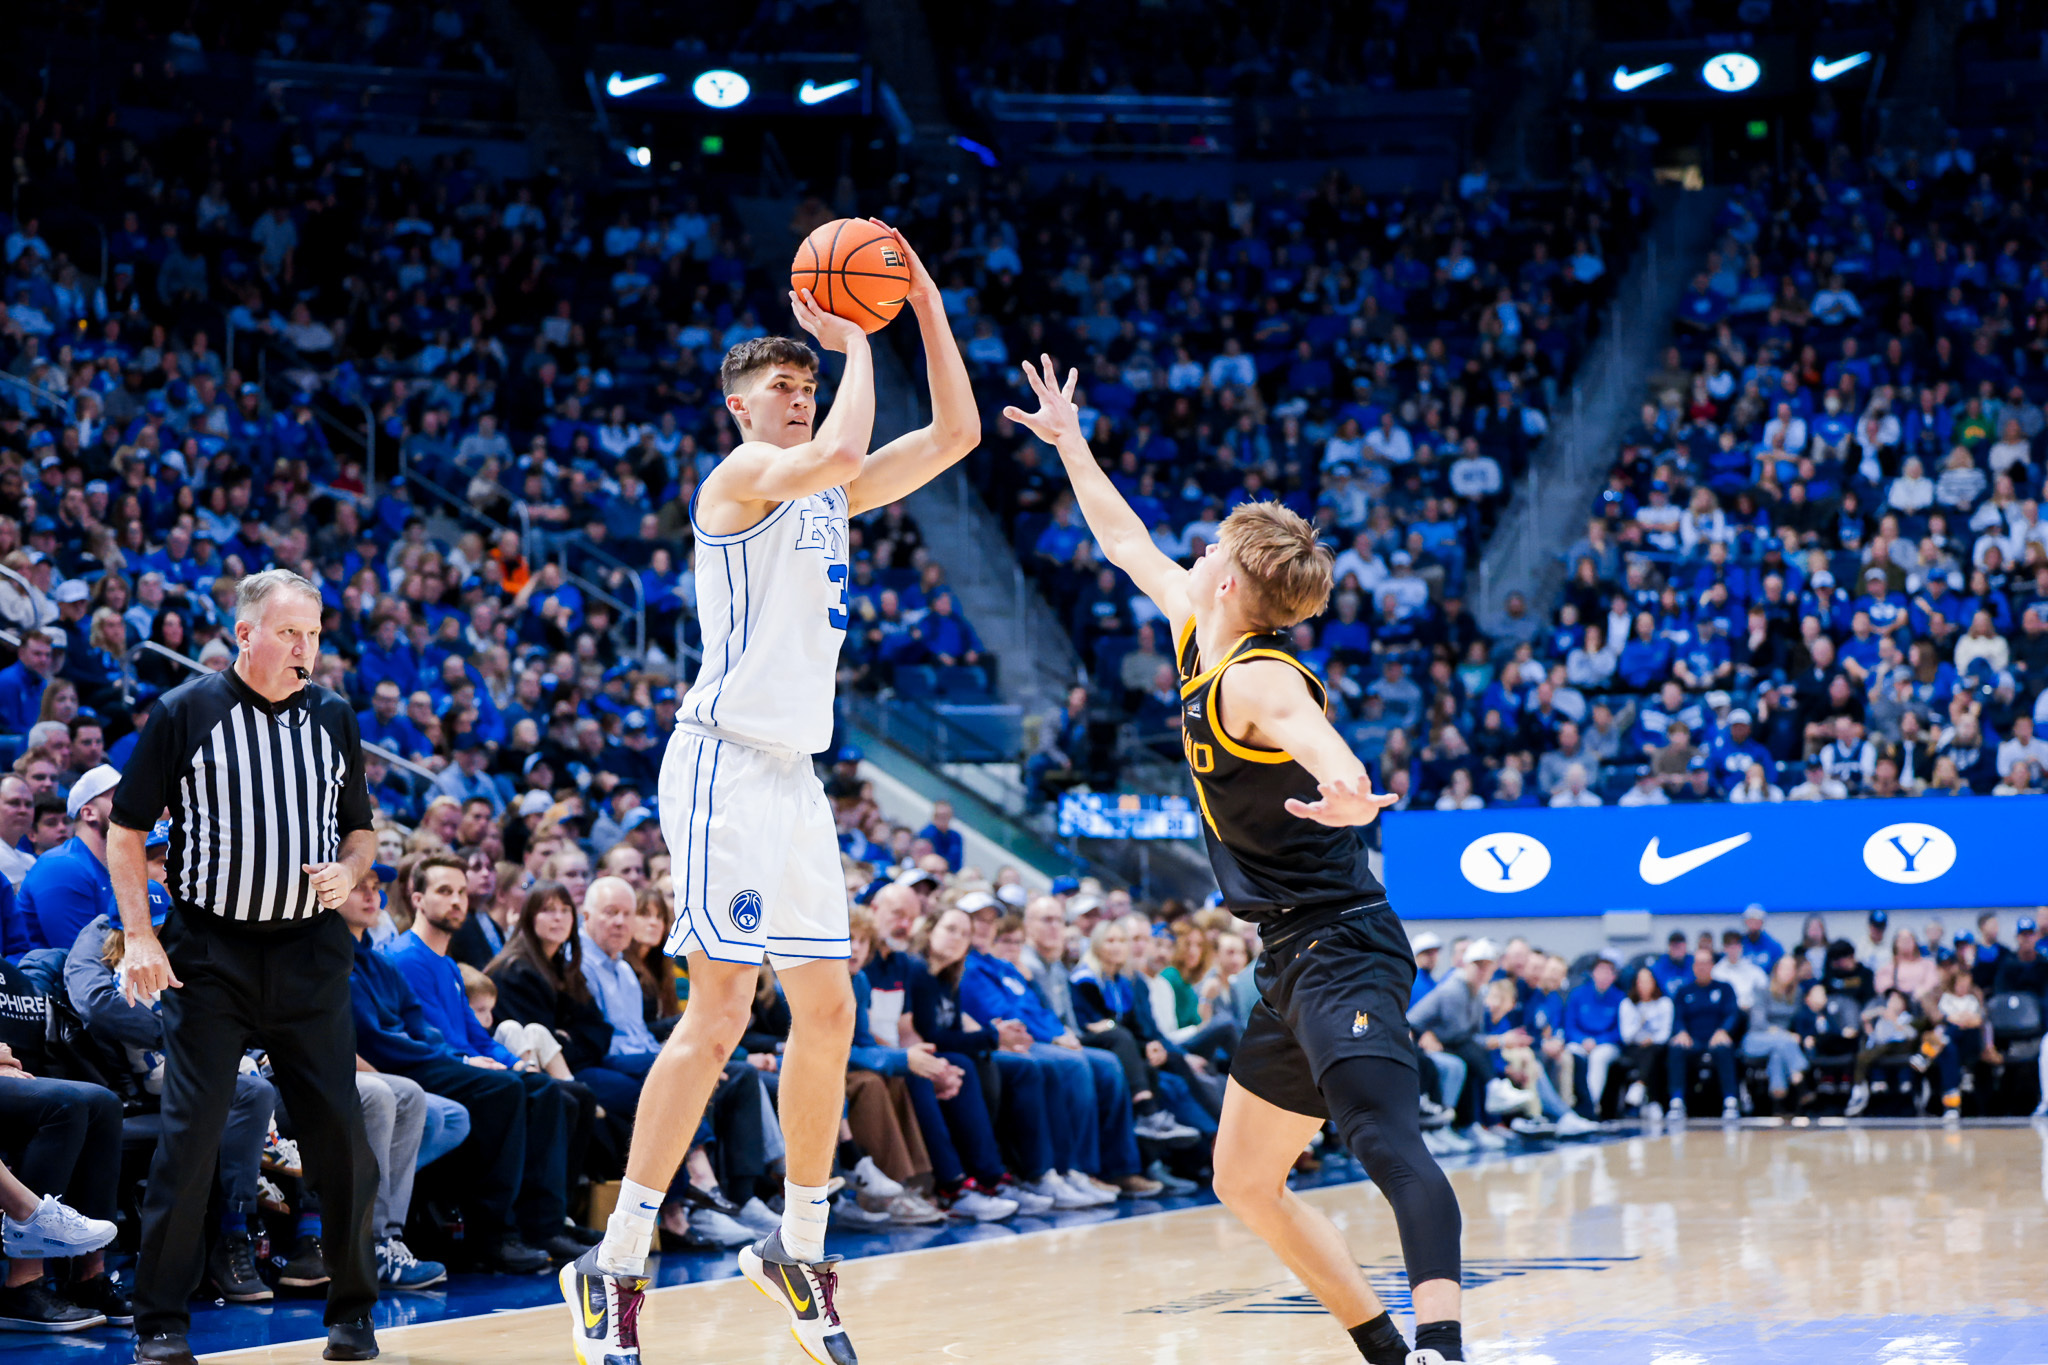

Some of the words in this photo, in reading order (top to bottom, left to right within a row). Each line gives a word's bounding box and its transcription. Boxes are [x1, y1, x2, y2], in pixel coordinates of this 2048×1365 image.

[1484, 845, 1527, 881] Y
[1885, 835, 1935, 872] Y
[743, 915, 754, 925] Y
